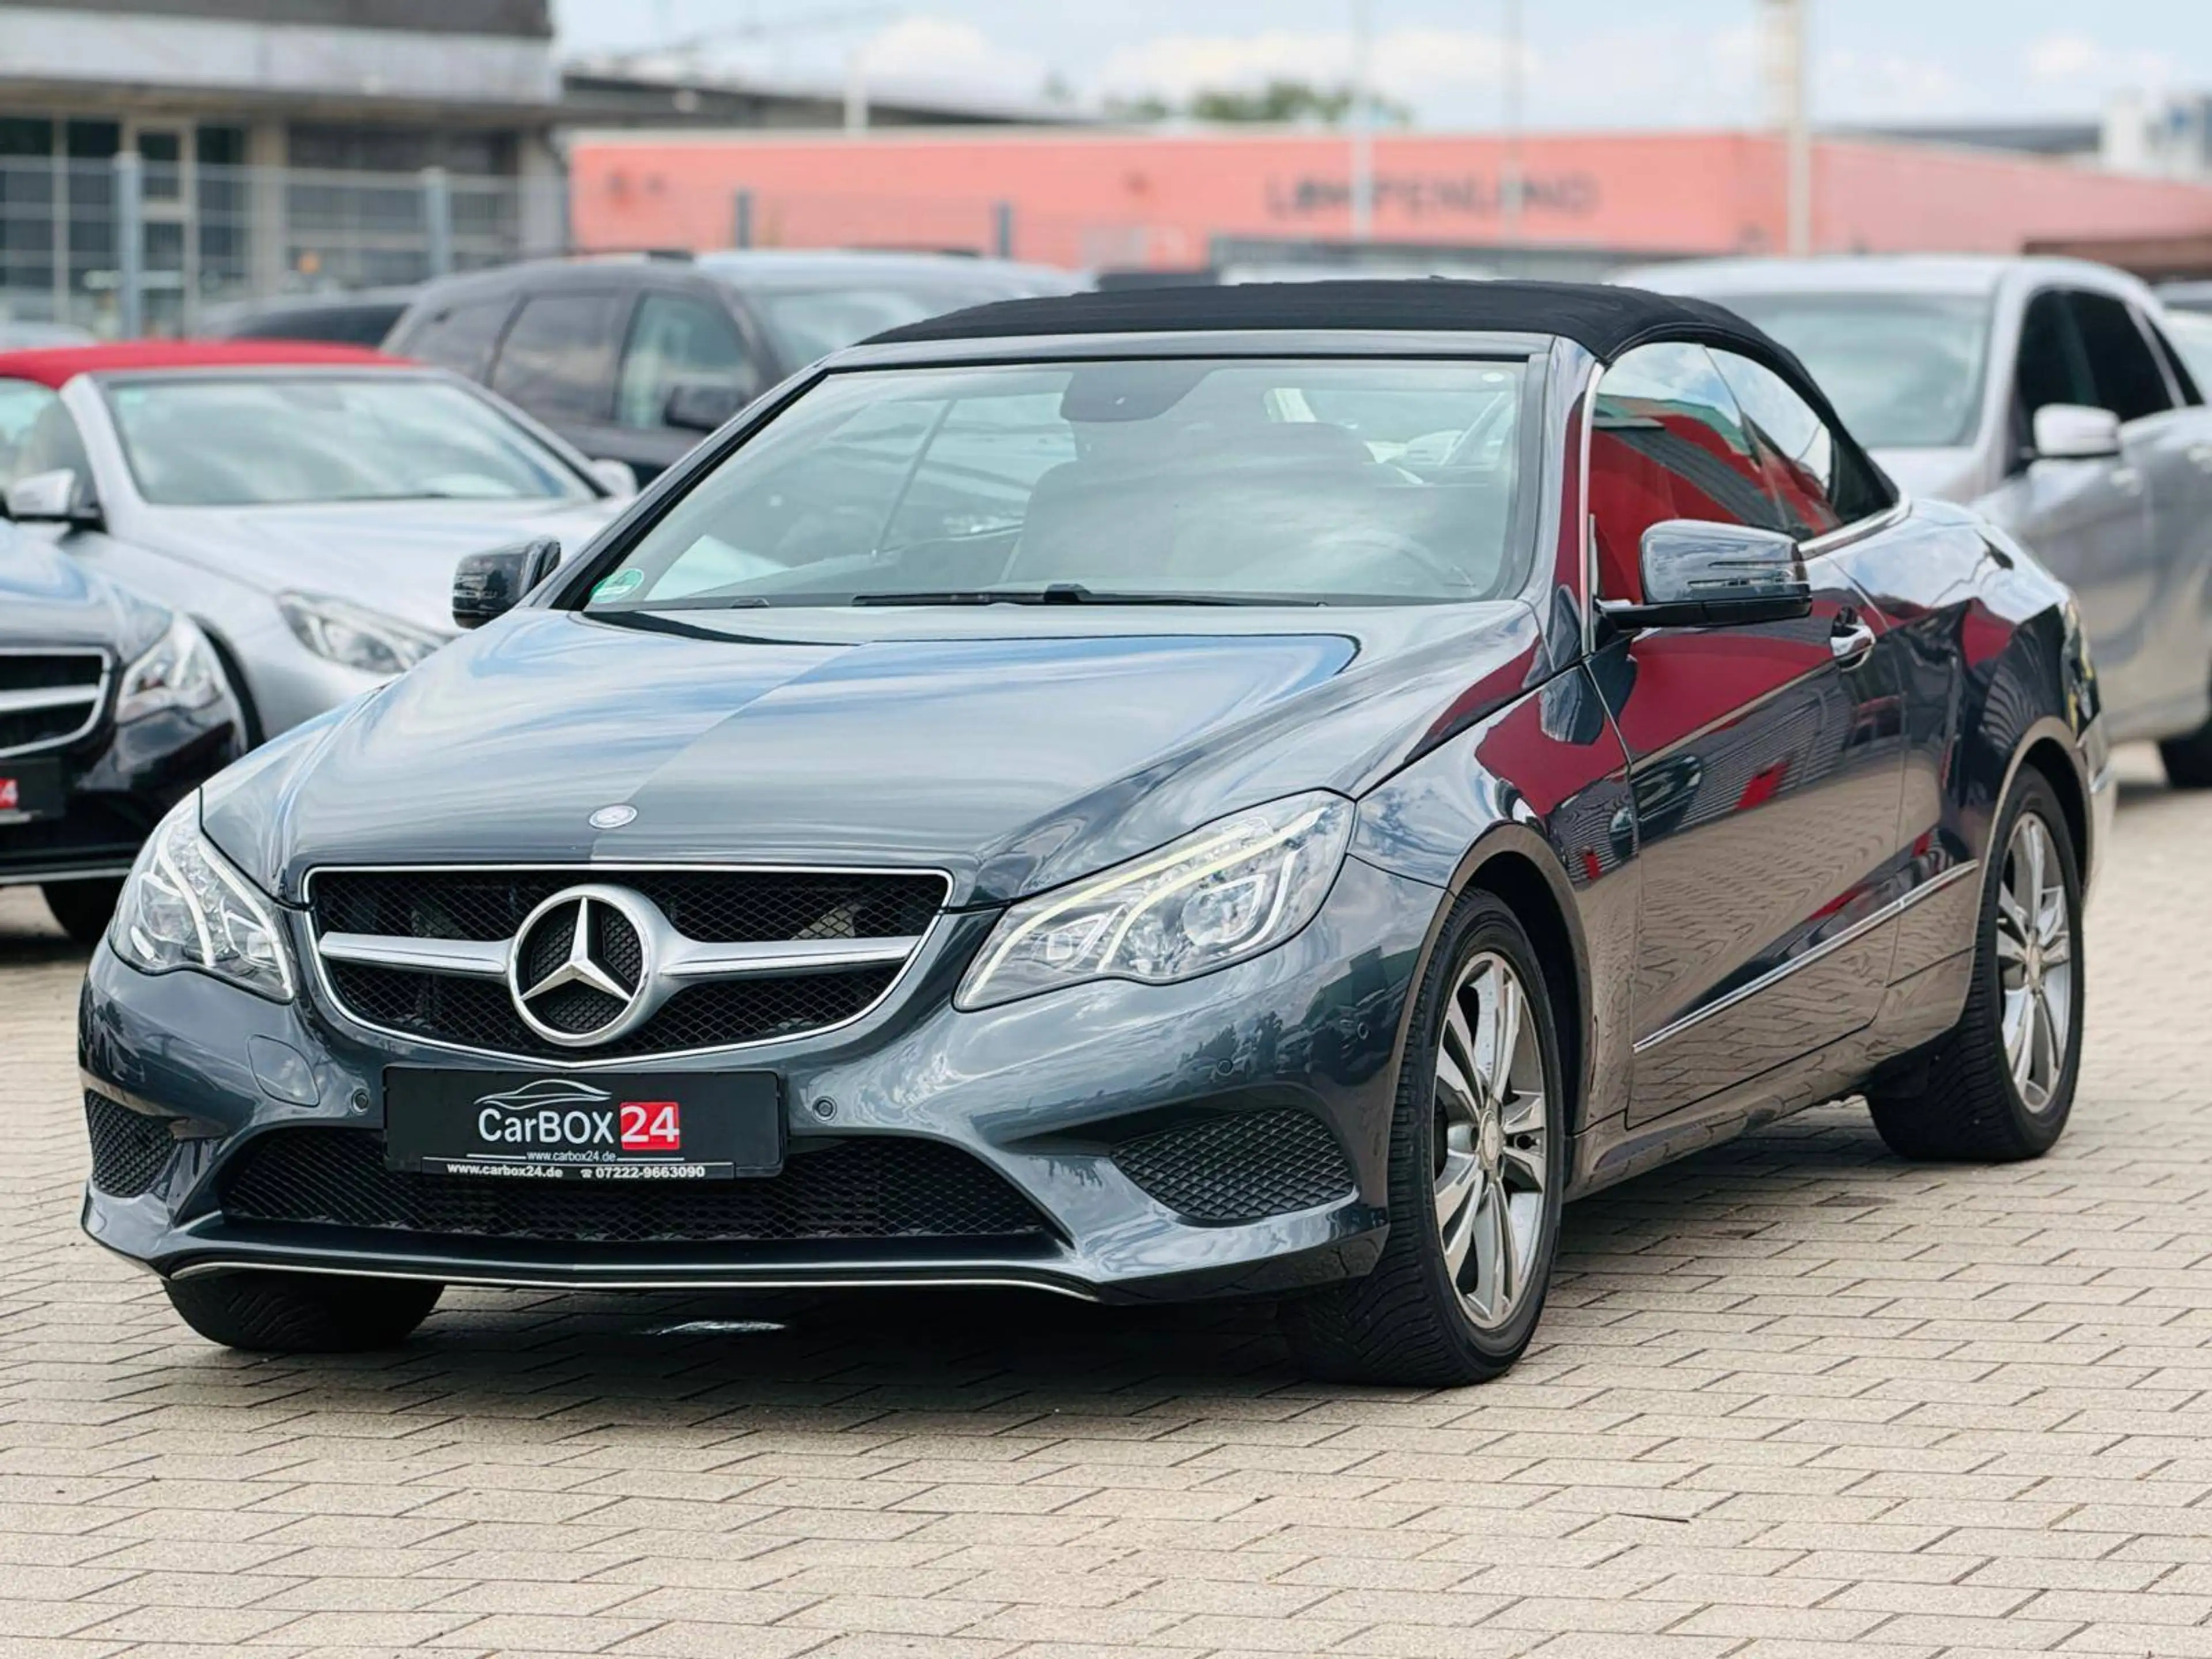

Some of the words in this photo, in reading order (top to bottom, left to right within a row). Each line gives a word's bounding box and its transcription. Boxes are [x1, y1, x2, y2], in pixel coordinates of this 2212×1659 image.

[479, 1108, 614, 1144] CarBOX
[620, 1106, 680, 1142] 24
[527, 1150, 616, 1162] www.carbox24.de
[447, 1158, 563, 1177] www.carbox24.de
[595, 1166, 705, 1179] 07222-9663090
